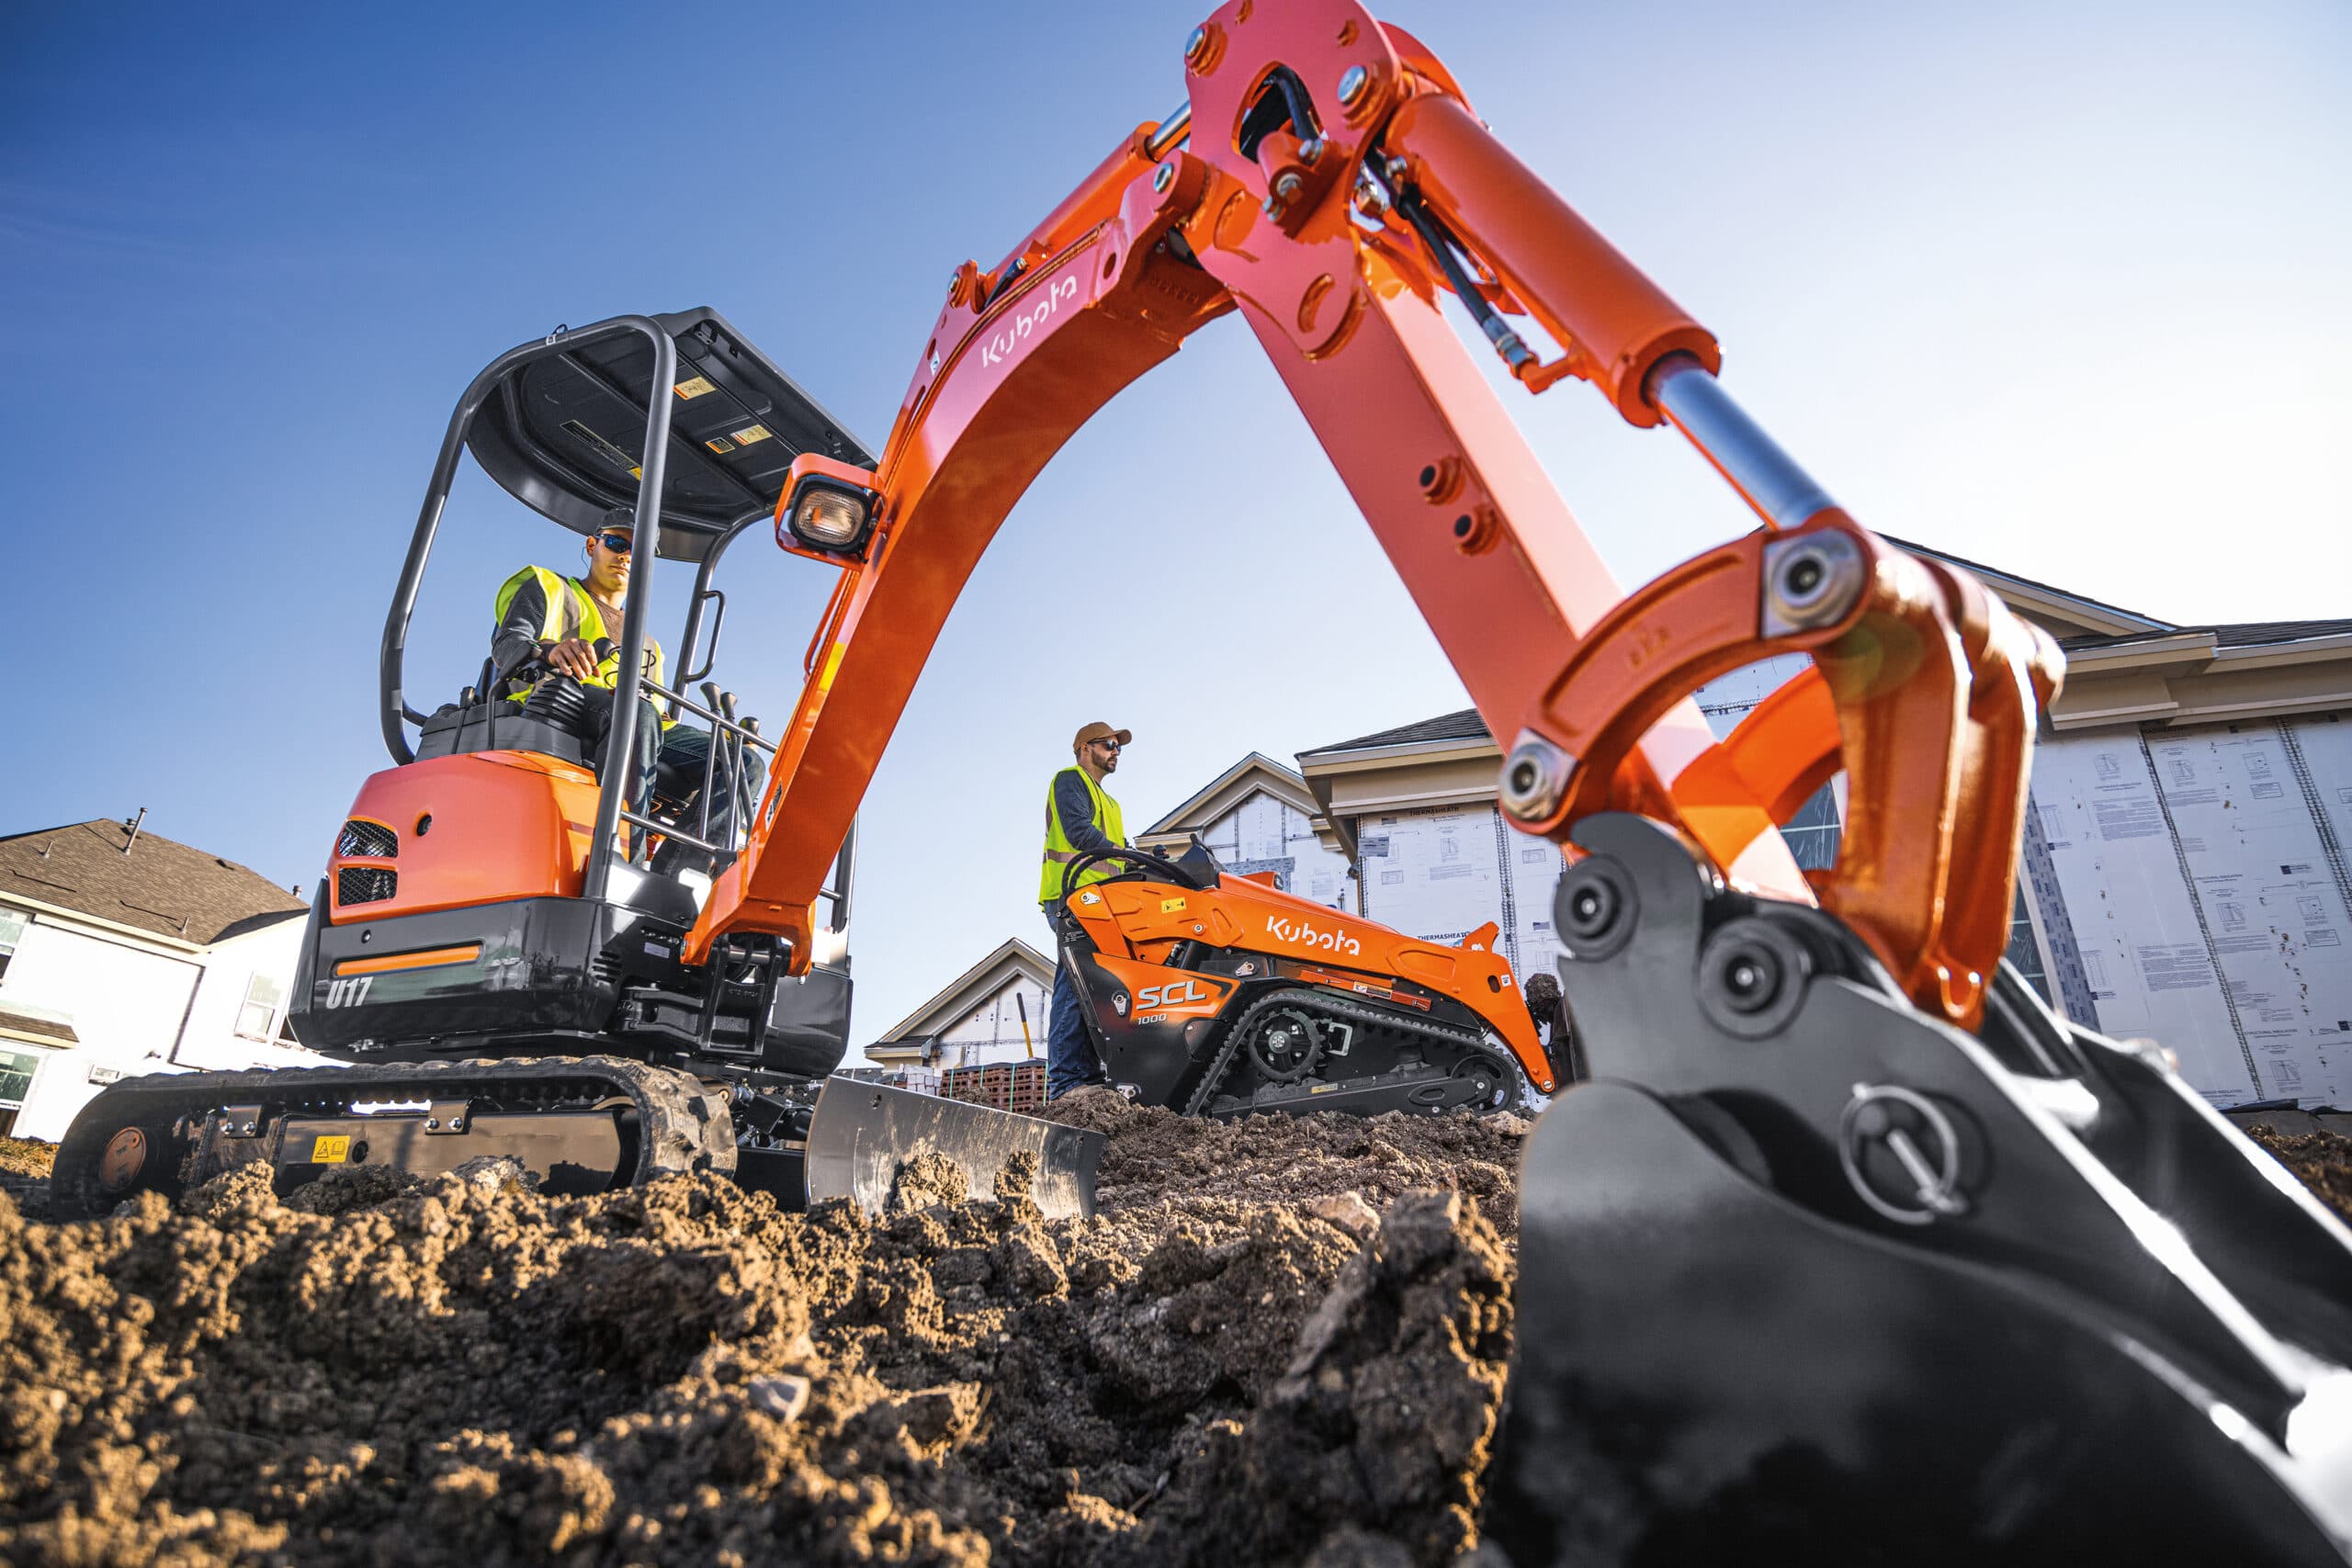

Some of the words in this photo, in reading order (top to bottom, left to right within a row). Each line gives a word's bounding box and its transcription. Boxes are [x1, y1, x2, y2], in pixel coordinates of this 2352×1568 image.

[982, 276, 1077, 367] Kubota
[1266, 915, 1361, 956] Kubota
[326, 976, 374, 1010] U17
[1136, 979, 1206, 1010] SCL
[1137, 1013, 1168, 1025] 1000
